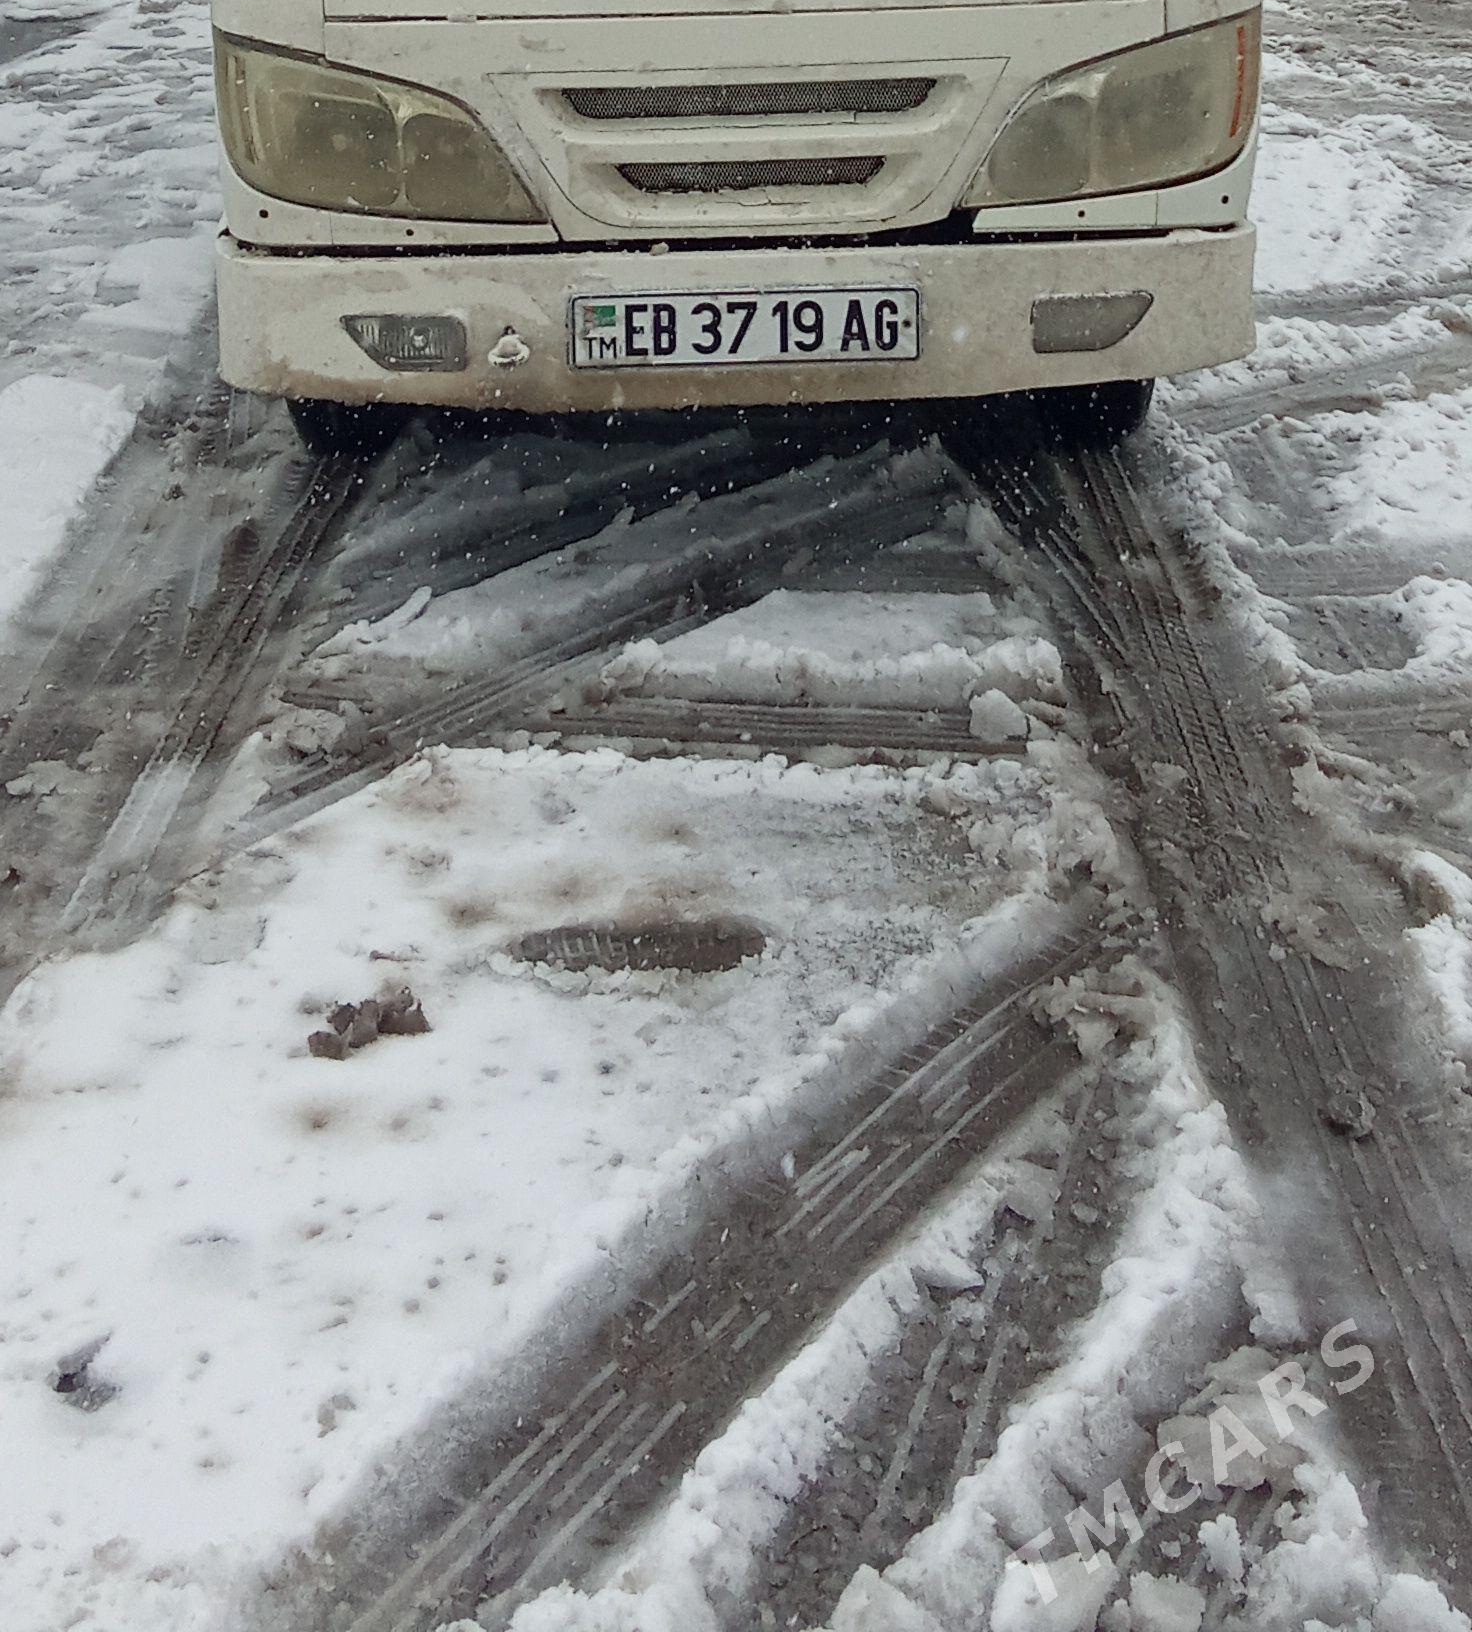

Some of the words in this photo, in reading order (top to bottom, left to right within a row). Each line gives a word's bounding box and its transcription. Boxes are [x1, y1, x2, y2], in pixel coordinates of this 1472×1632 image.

[624, 304, 677, 357] EB
[691, 301, 758, 355] 37
[772, 300, 824, 353] 19
[840, 299, 898, 352] AG
[583, 337, 617, 360] TM
